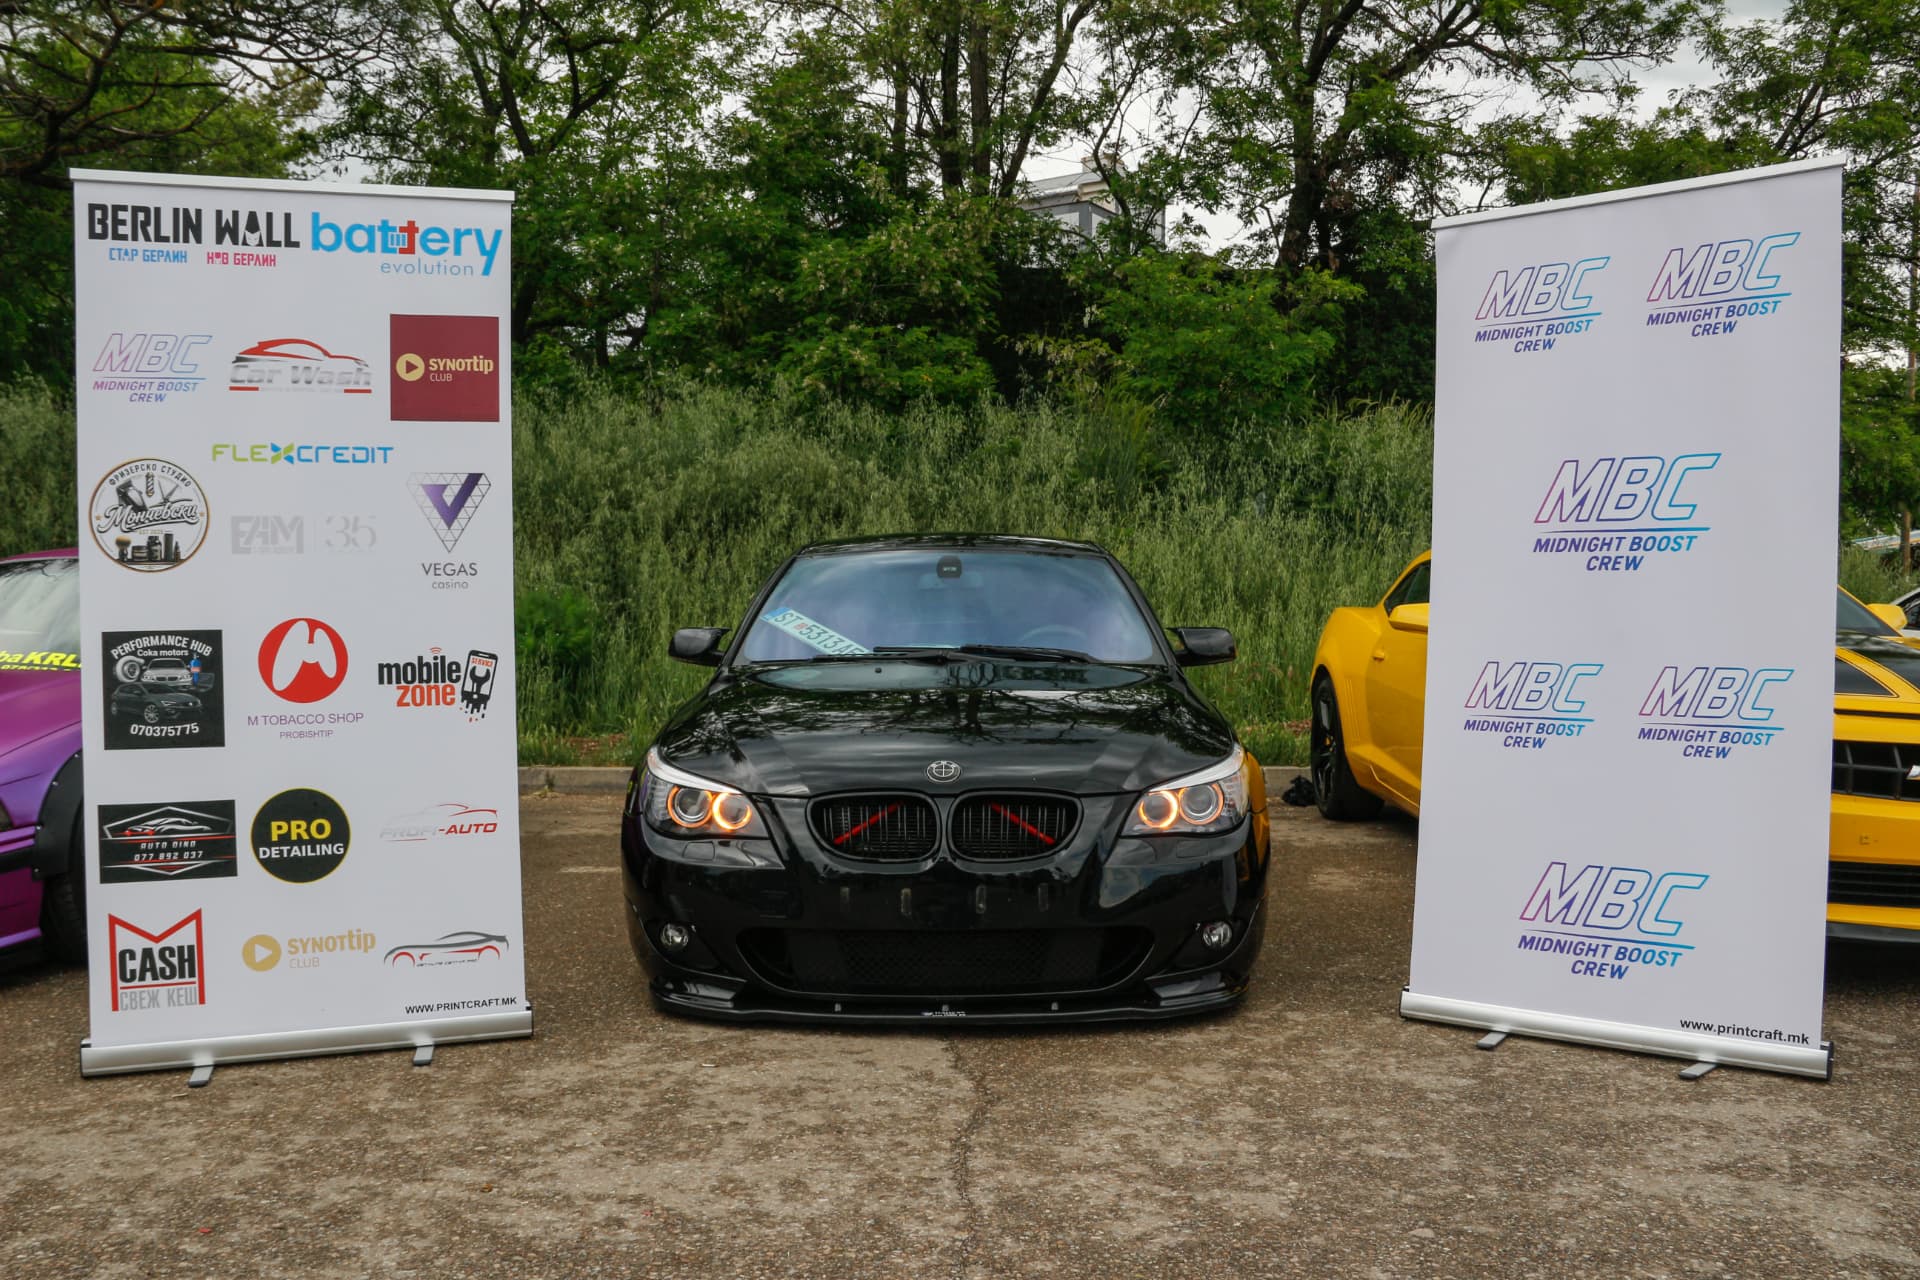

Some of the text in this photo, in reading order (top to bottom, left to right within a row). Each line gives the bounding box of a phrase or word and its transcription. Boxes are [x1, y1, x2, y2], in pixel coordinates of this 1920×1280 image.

[88, 203, 301, 248] BERLIN WALL
[311, 212, 503, 276] battery
[142, 249, 187, 263] БЕРЛИН
[233, 252, 276, 267] БЕРЛИН
[380, 258, 474, 276] evolution
[1647, 232, 1801, 302] MBC
[1475, 256, 1611, 320] MBC
[1646, 300, 1782, 326] MIDNIGHT BOOST
[1475, 319, 1593, 342] MIDNIGHT BOOST
[1691, 320, 1738, 337] CREW
[92, 333, 213, 373] MBC
[1514, 338, 1556, 353] CREW
[92, 381, 199, 392] MIDNIGHT BOOST
[429, 373, 453, 382] CLUB
[129, 393, 167, 402] CREW
[1534, 453, 1722, 523] MBC
[1533, 535, 1698, 553] MIDNIGHT BOOST
[421, 562, 478, 576] VEGAS
[1586, 555, 1644, 571] CREW
[431, 580, 469, 590] casino
[774, 612, 803, 626] ST
[110, 634, 213, 660] PERFORMANCE HUB
[137, 649, 189, 657] Coka motors
[378, 655, 461, 685] mobile
[396, 683, 456, 707] zone
[1464, 661, 1604, 712] MBC
[1639, 666, 1795, 721] MBC
[247, 712, 364, 726] M TOBACCO SHOP
[1464, 720, 1585, 736] MIDNIGHT BOOST
[130, 722, 200, 737] 070375775
[280, 729, 334, 739] PROBISHTIP
[1638, 727, 1775, 746] MIDNIGHT BOOST
[1503, 735, 1547, 749] CREW
[1683, 744, 1731, 759] CREW
[271, 818, 332, 842] PRO
[134, 853, 154, 862] 077
[259, 843, 345, 859] DETAILING
[1519, 861, 1710, 936] MBC
[1518, 935, 1683, 967] MIDNIGHT BOOST
[118, 944, 196, 983] CASH
[289, 957, 320, 969] CLUB
[1571, 960, 1629, 980] CREW
[120, 985, 198, 1011] СВЕЖ КЕШ
[405, 997, 517, 1014] WWW.PRINTCRAFT.MK
[1680, 1019, 1809, 1045] www.printcraft.mk
